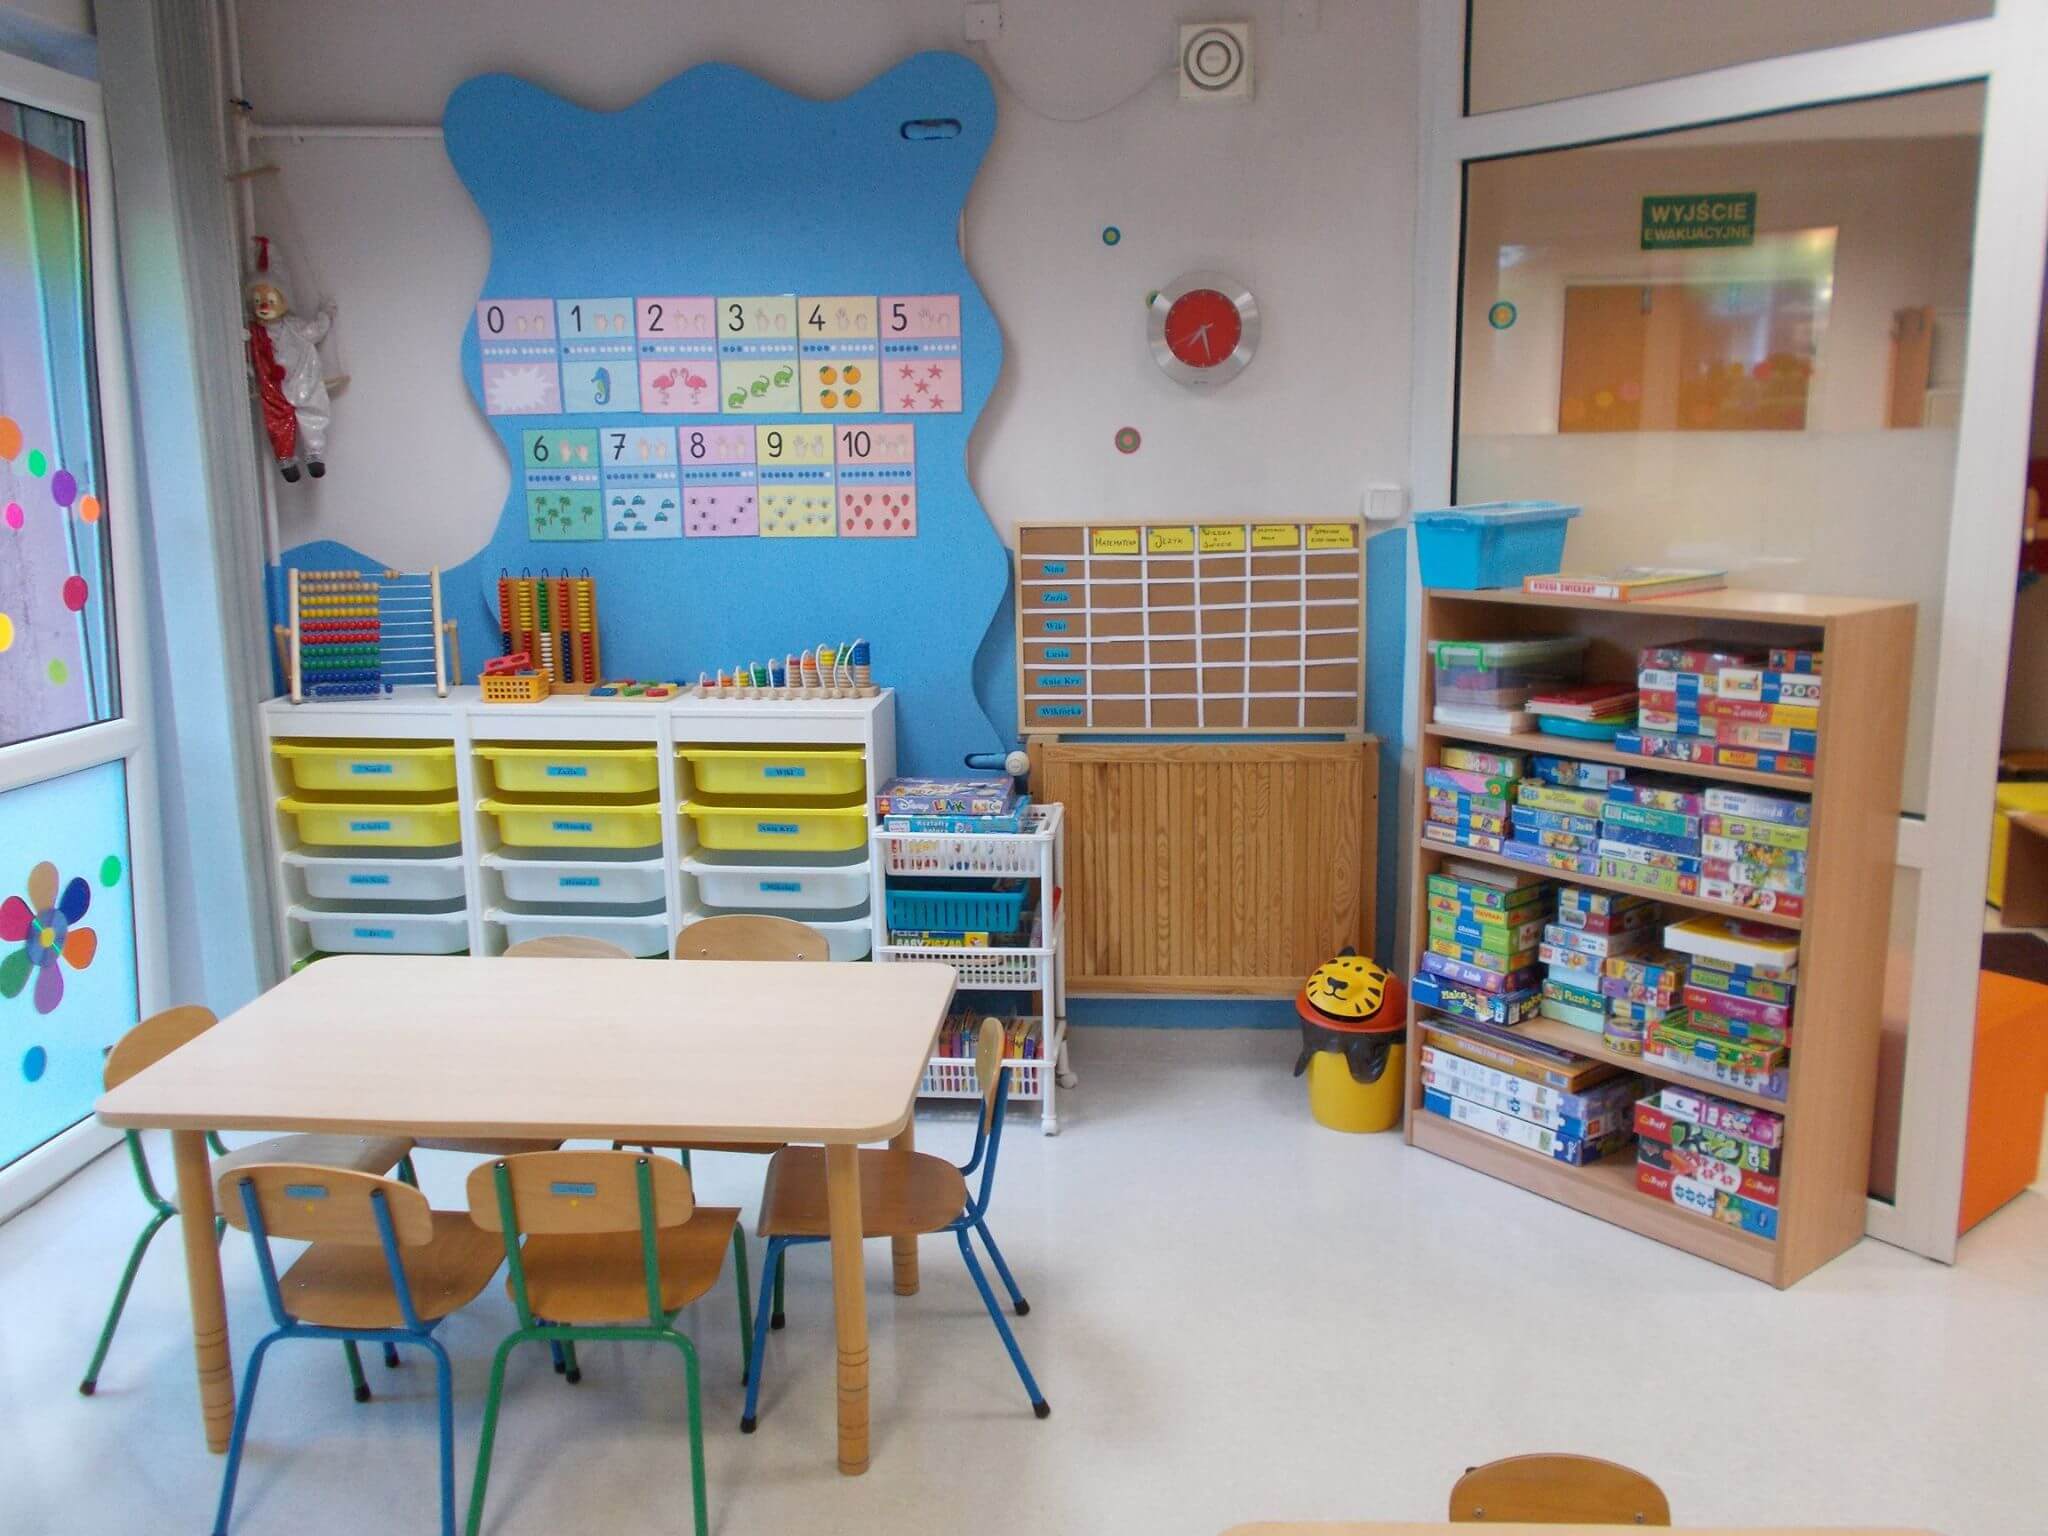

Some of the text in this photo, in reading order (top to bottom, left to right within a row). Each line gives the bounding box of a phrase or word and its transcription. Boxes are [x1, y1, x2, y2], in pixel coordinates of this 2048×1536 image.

[1651, 200, 1748, 222] WYJŚCIE
[1643, 226, 1750, 240] EWAKUACYJNE
[488, 306, 504, 333] 0
[572, 306, 580, 331] 1
[648, 305, 663, 331] 2
[729, 304, 744, 331] 3
[809, 305, 825, 330] 4
[892, 304, 907, 331] 5
[534, 436, 548, 461] 6
[611, 434, 625, 460] 7
[691, 433, 705, 458] 8
[768, 432, 782, 457] 9
[843, 431, 870, 457] 10
[896, 798, 930, 813] Disney
